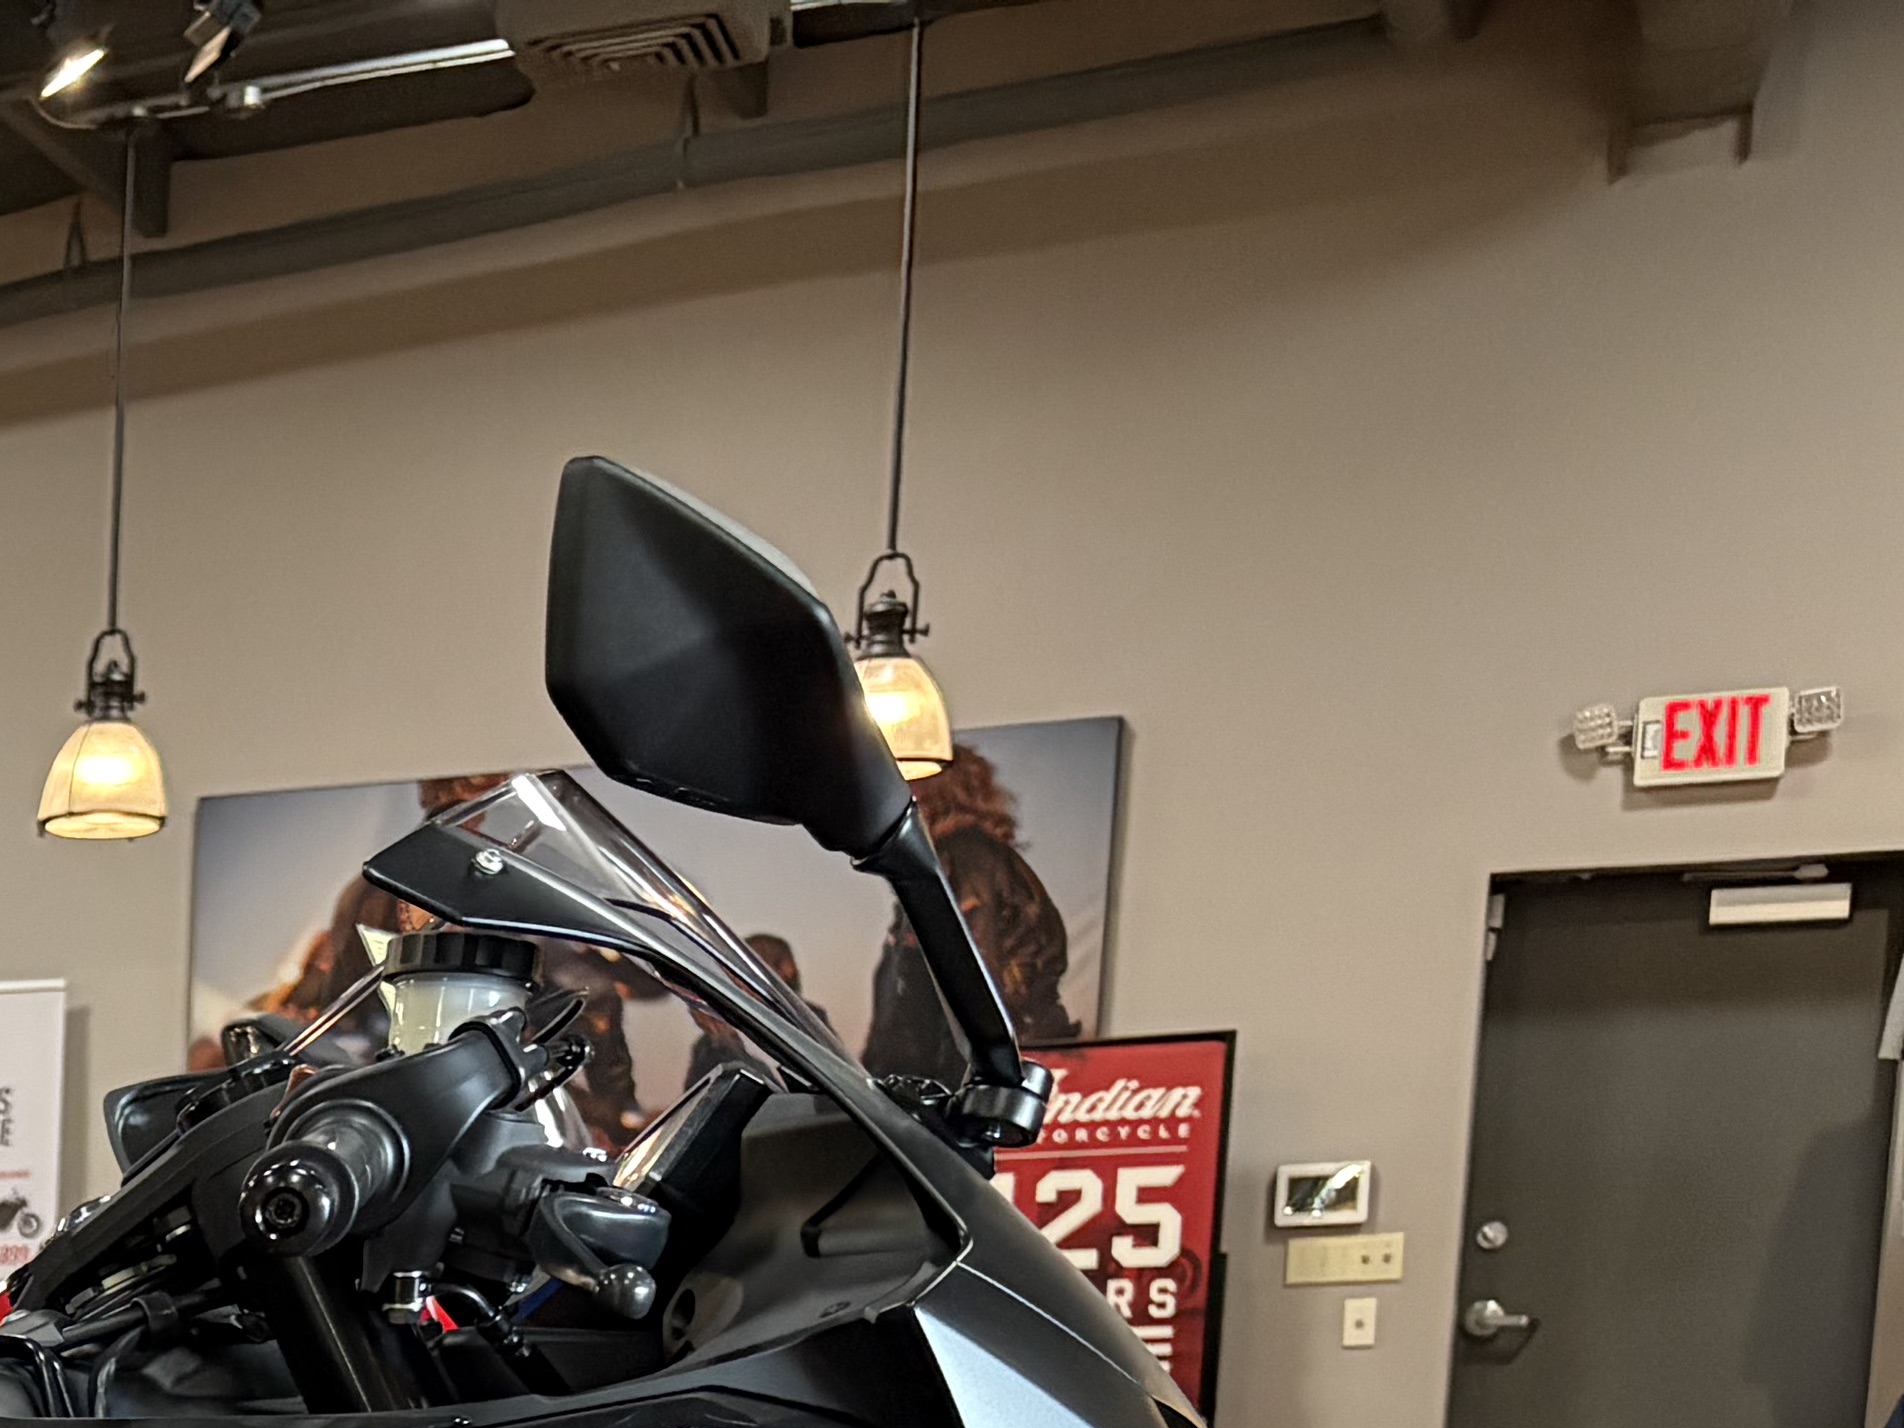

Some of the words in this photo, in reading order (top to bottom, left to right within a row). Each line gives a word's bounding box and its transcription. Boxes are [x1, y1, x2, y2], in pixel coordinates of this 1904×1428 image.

[1659, 692, 1772, 772] EXIT
[1042, 1068, 1202, 1124] Indian
[1038, 1123, 1191, 1144] ORCYCLE
[990, 1164, 1187, 1271] 25
